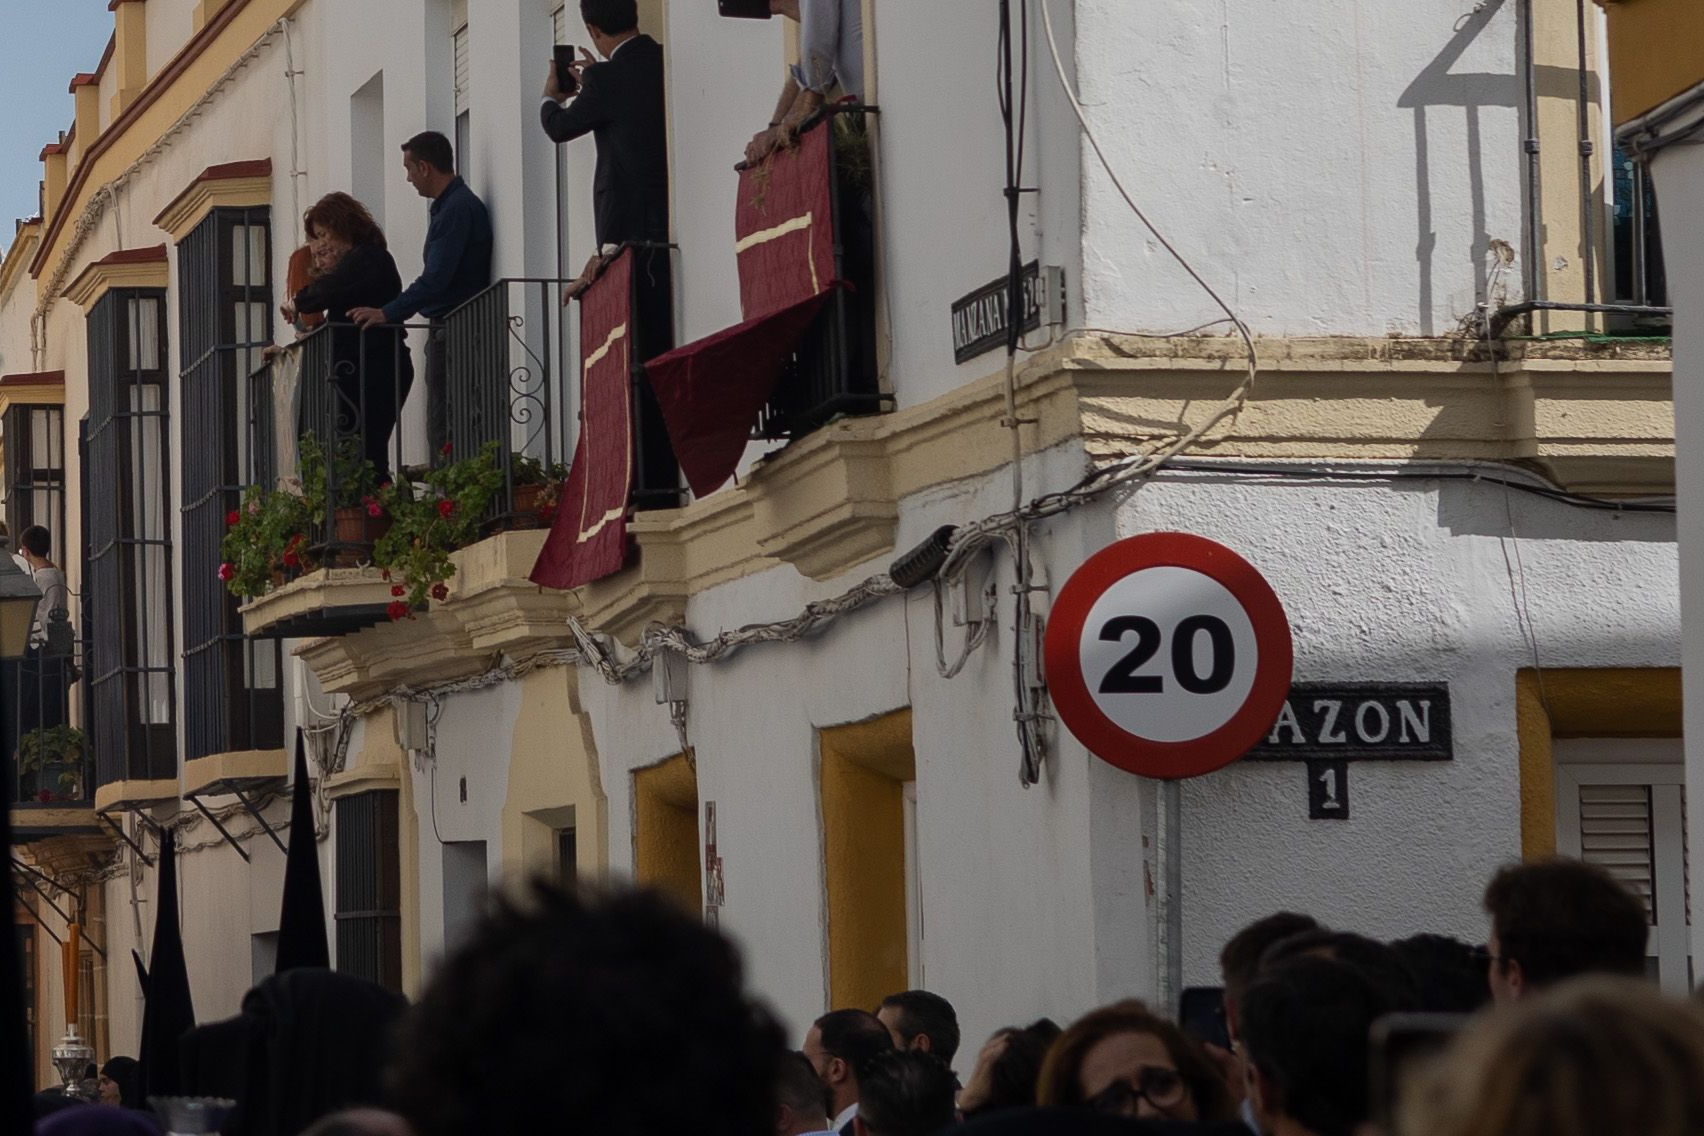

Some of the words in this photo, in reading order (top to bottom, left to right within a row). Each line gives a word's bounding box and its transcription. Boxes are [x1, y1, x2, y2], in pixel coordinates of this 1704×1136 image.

[953, 293, 1003, 350] MANZANA
[1098, 614, 1236, 695] 20
[1268, 699, 1432, 744] AZON
[1318, 768, 1341, 809] 1
